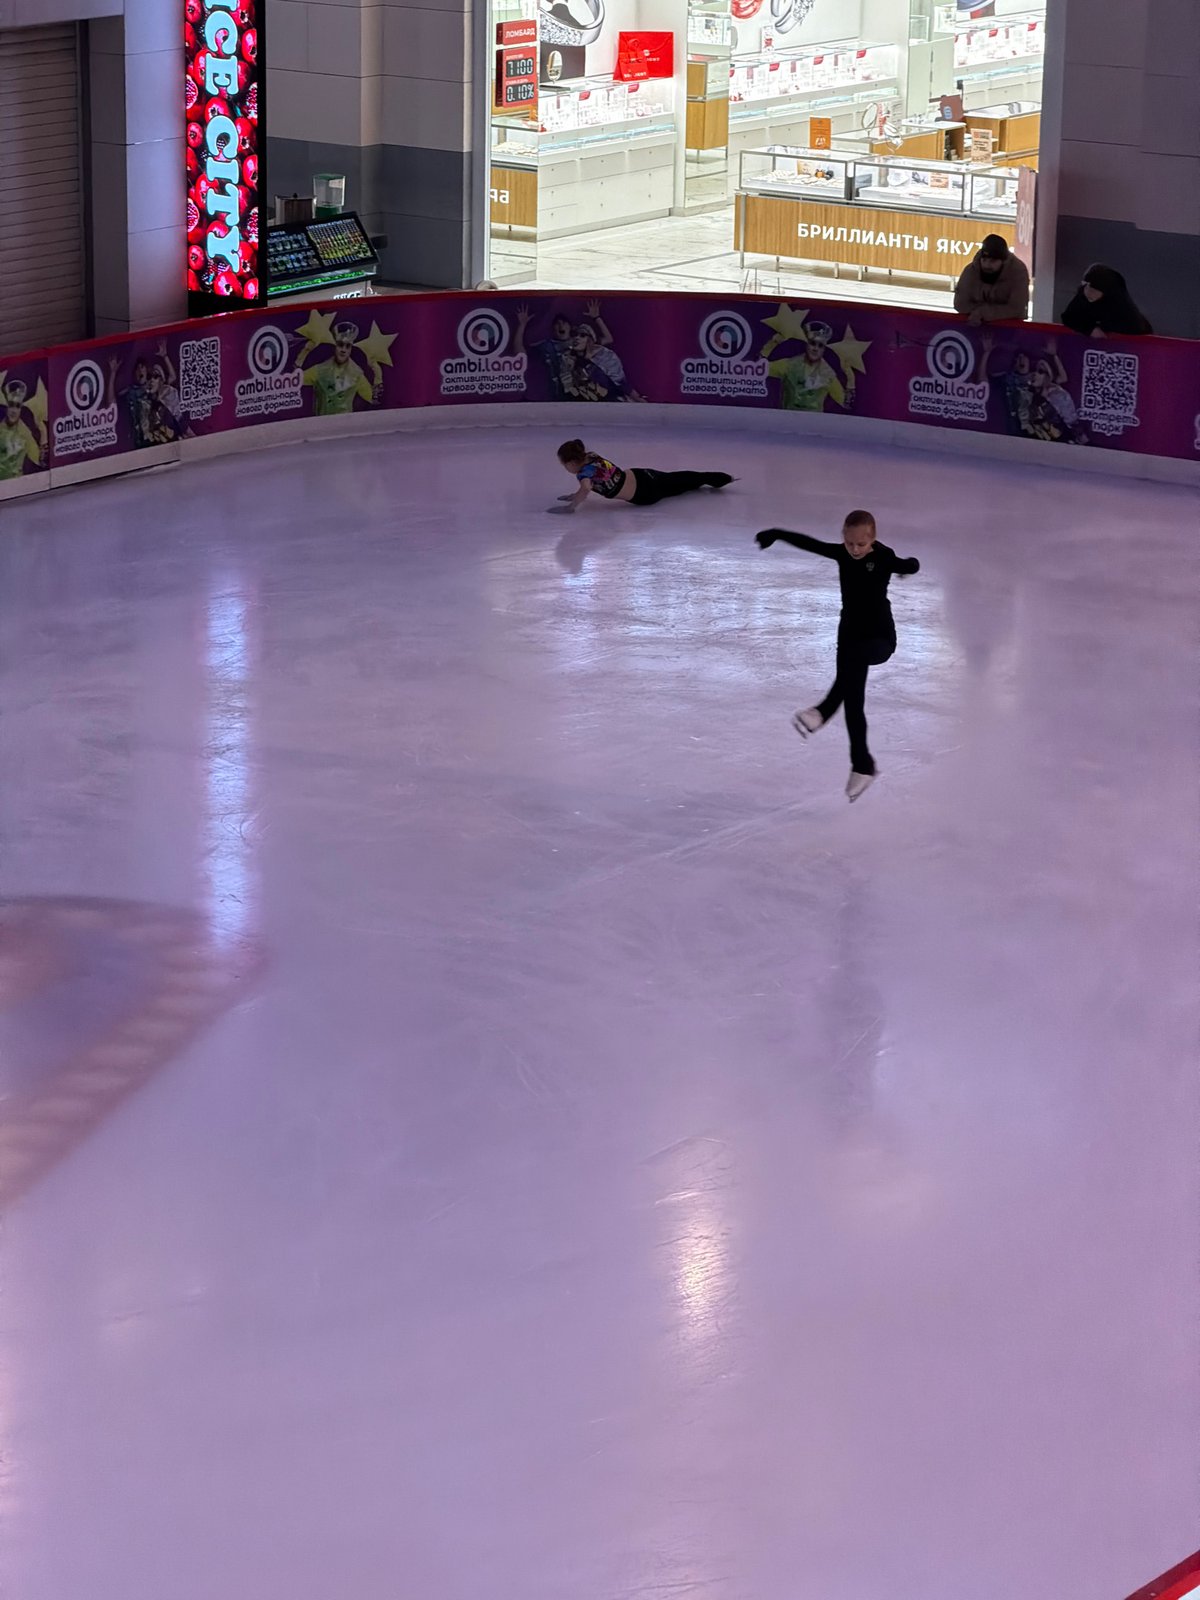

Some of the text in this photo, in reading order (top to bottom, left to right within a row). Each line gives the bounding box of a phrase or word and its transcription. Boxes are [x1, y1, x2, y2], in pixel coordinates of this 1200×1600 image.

[505, 28, 535, 39] ЛОМБАРД
[508, 59, 533, 76] 7100
[507, 84, 534, 102] 0.10%
[206, 115, 240, 273] CITY
[797, 223, 928, 251] БРИЛЛИАНТЫ
[444, 357, 523, 374] ambi.land
[685, 360, 765, 376] ambi.land
[238, 373, 300, 396] ambi.land
[686, 376, 763, 387] активити-парк
[720, 385, 766, 395] формата
[913, 379, 985, 400] ambi.land
[56, 408, 115, 433] ambi.land
